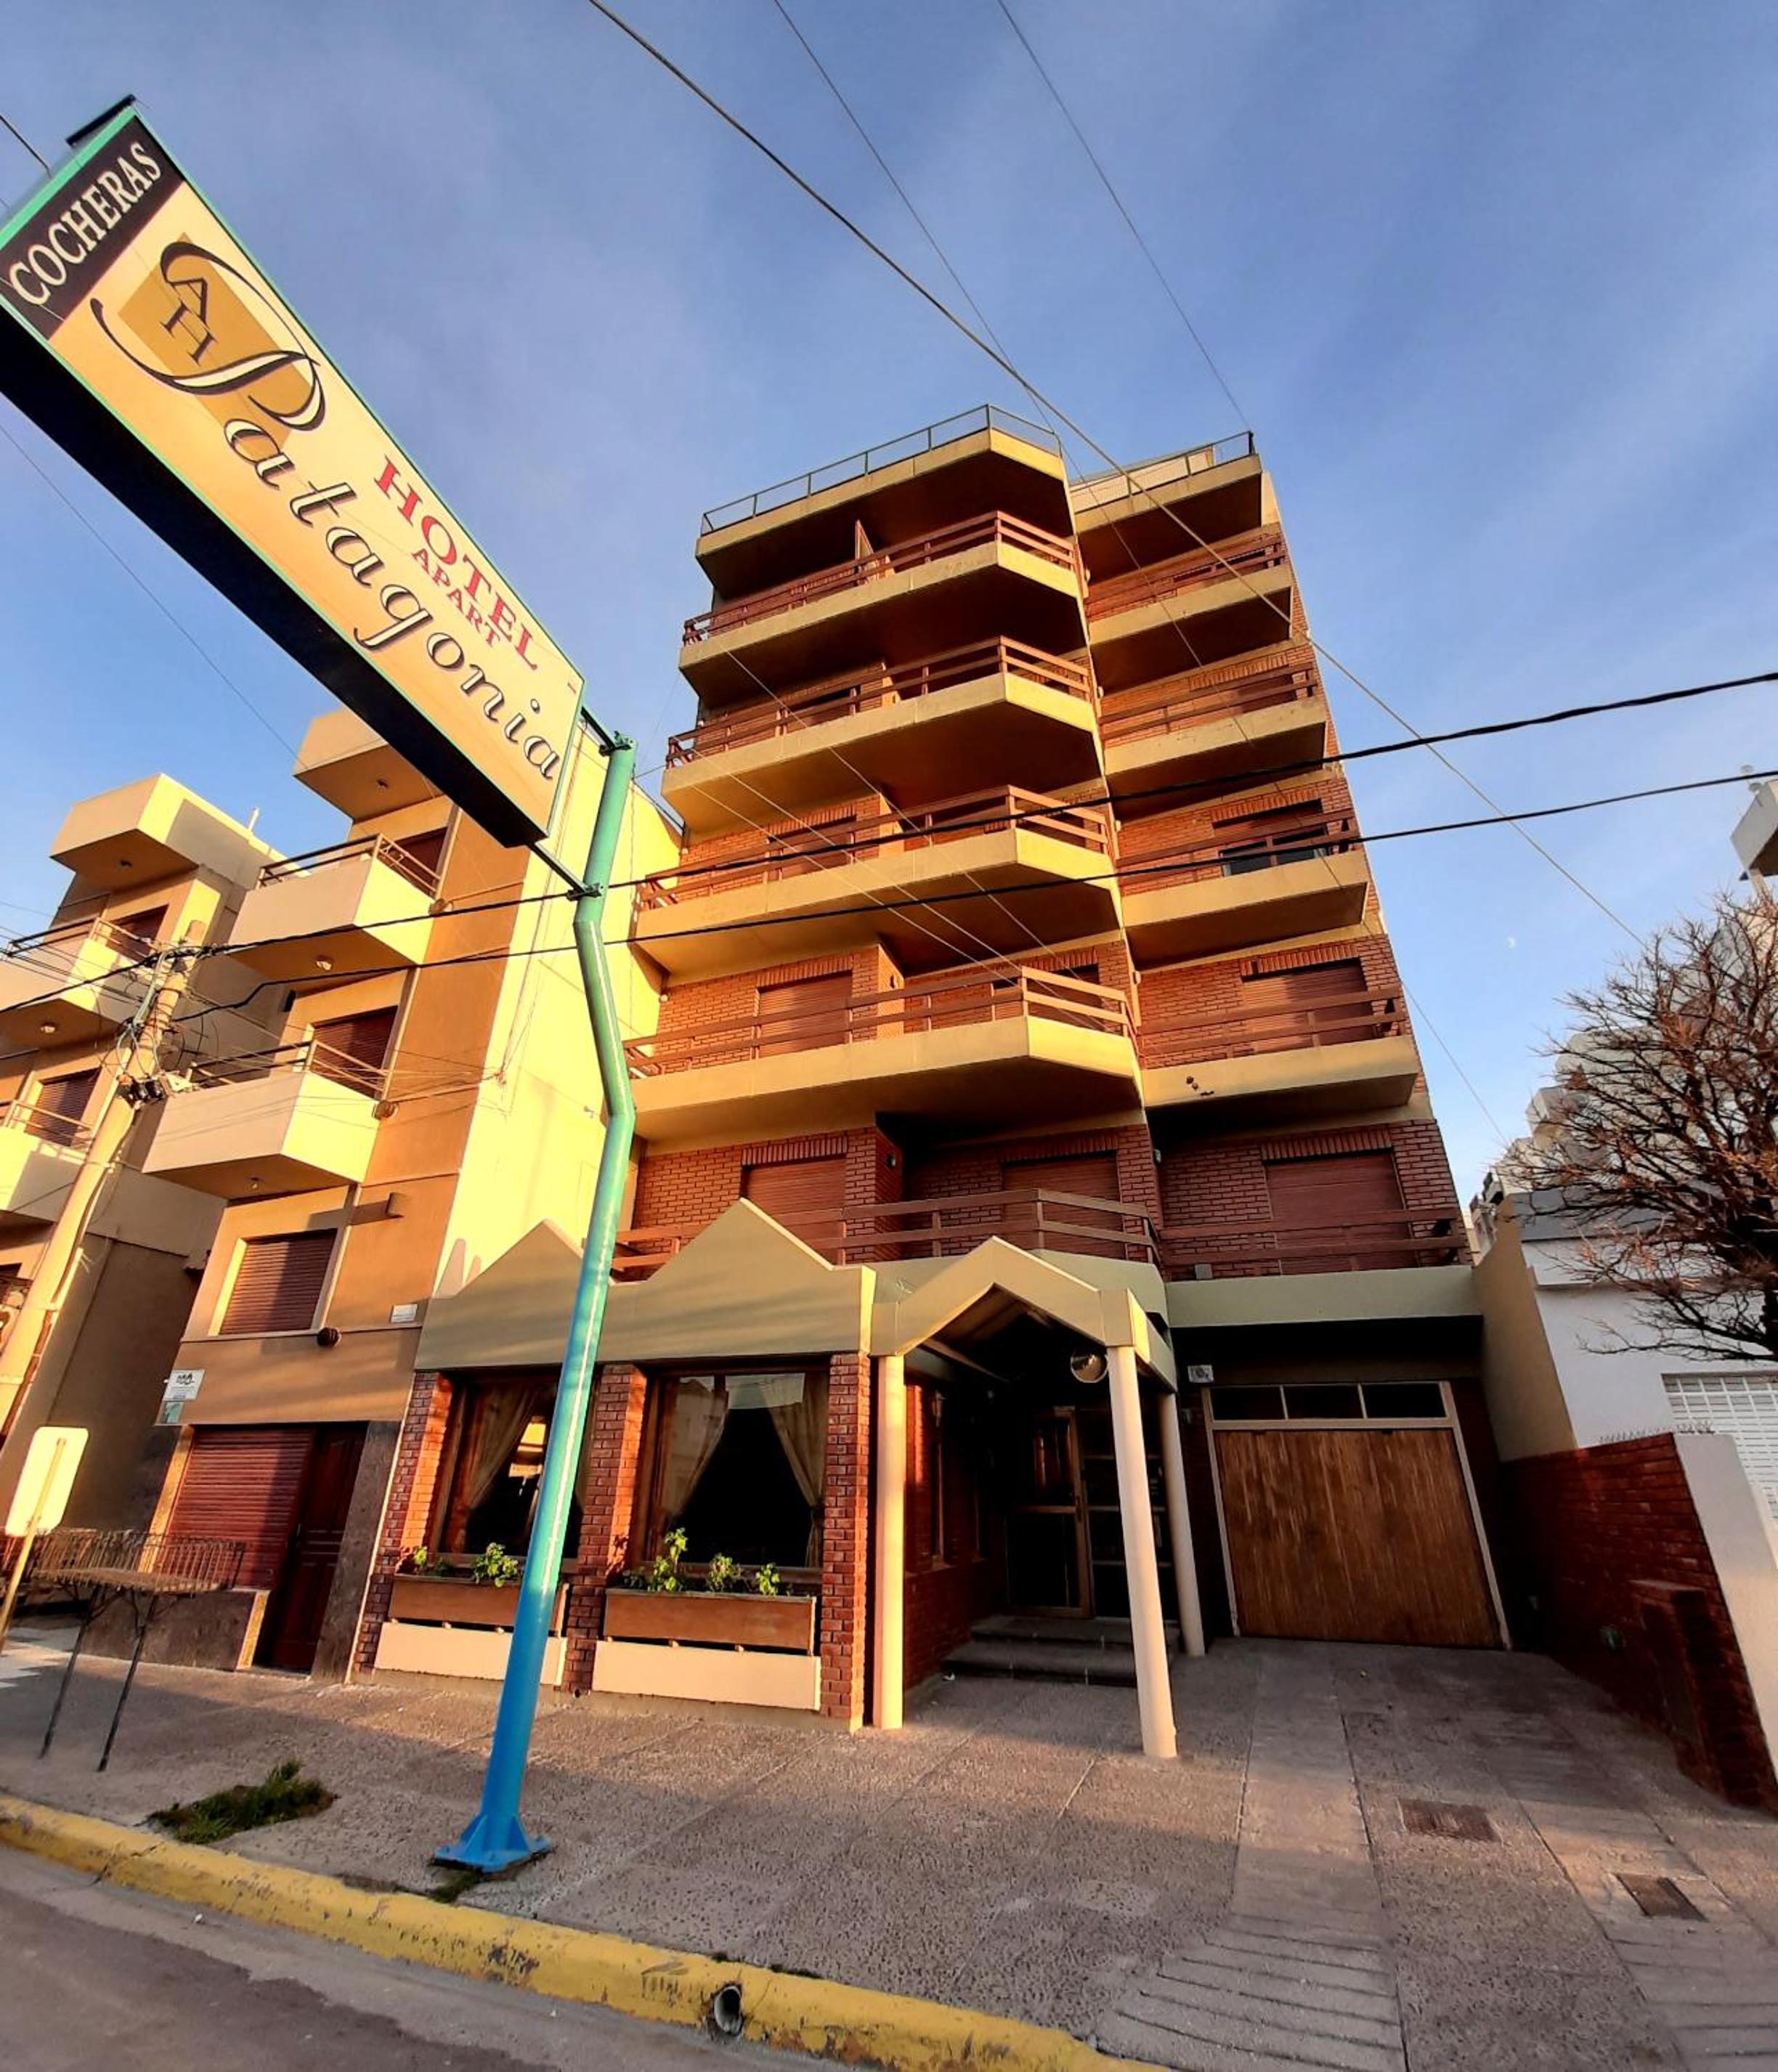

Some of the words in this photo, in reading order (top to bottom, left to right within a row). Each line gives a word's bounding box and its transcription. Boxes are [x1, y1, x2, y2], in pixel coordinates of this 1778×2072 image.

[9, 142, 162, 306] COCHERAS
[89, 241, 561, 781] Patagonia
[374, 454, 537, 670] HOTEL
[410, 547, 502, 648] APART
